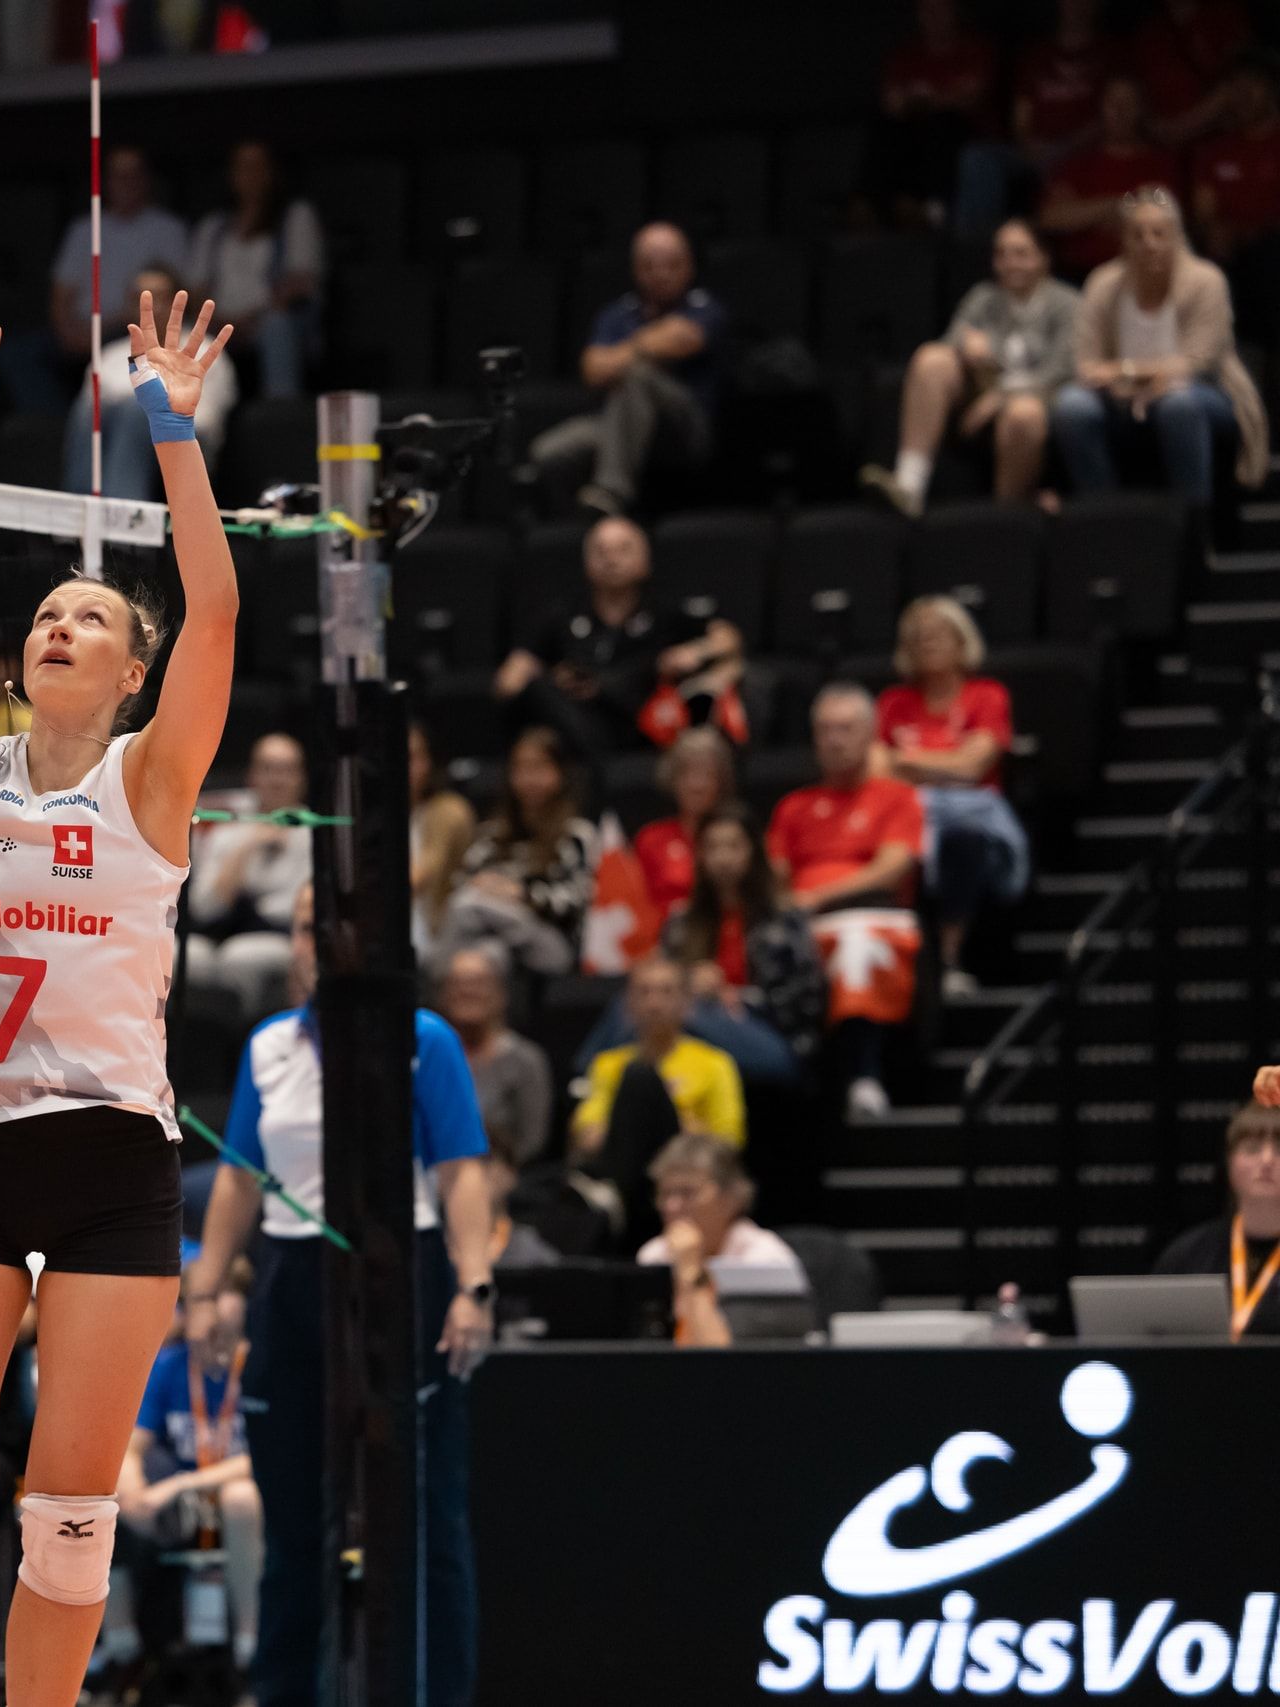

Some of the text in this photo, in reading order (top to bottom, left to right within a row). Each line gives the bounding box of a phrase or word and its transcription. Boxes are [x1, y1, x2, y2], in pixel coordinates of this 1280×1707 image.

[42, 793, 100, 813] CONCORDIA
[51, 865, 93, 879] SUISSE
[757, 1591, 1280, 1694] SwissVol
